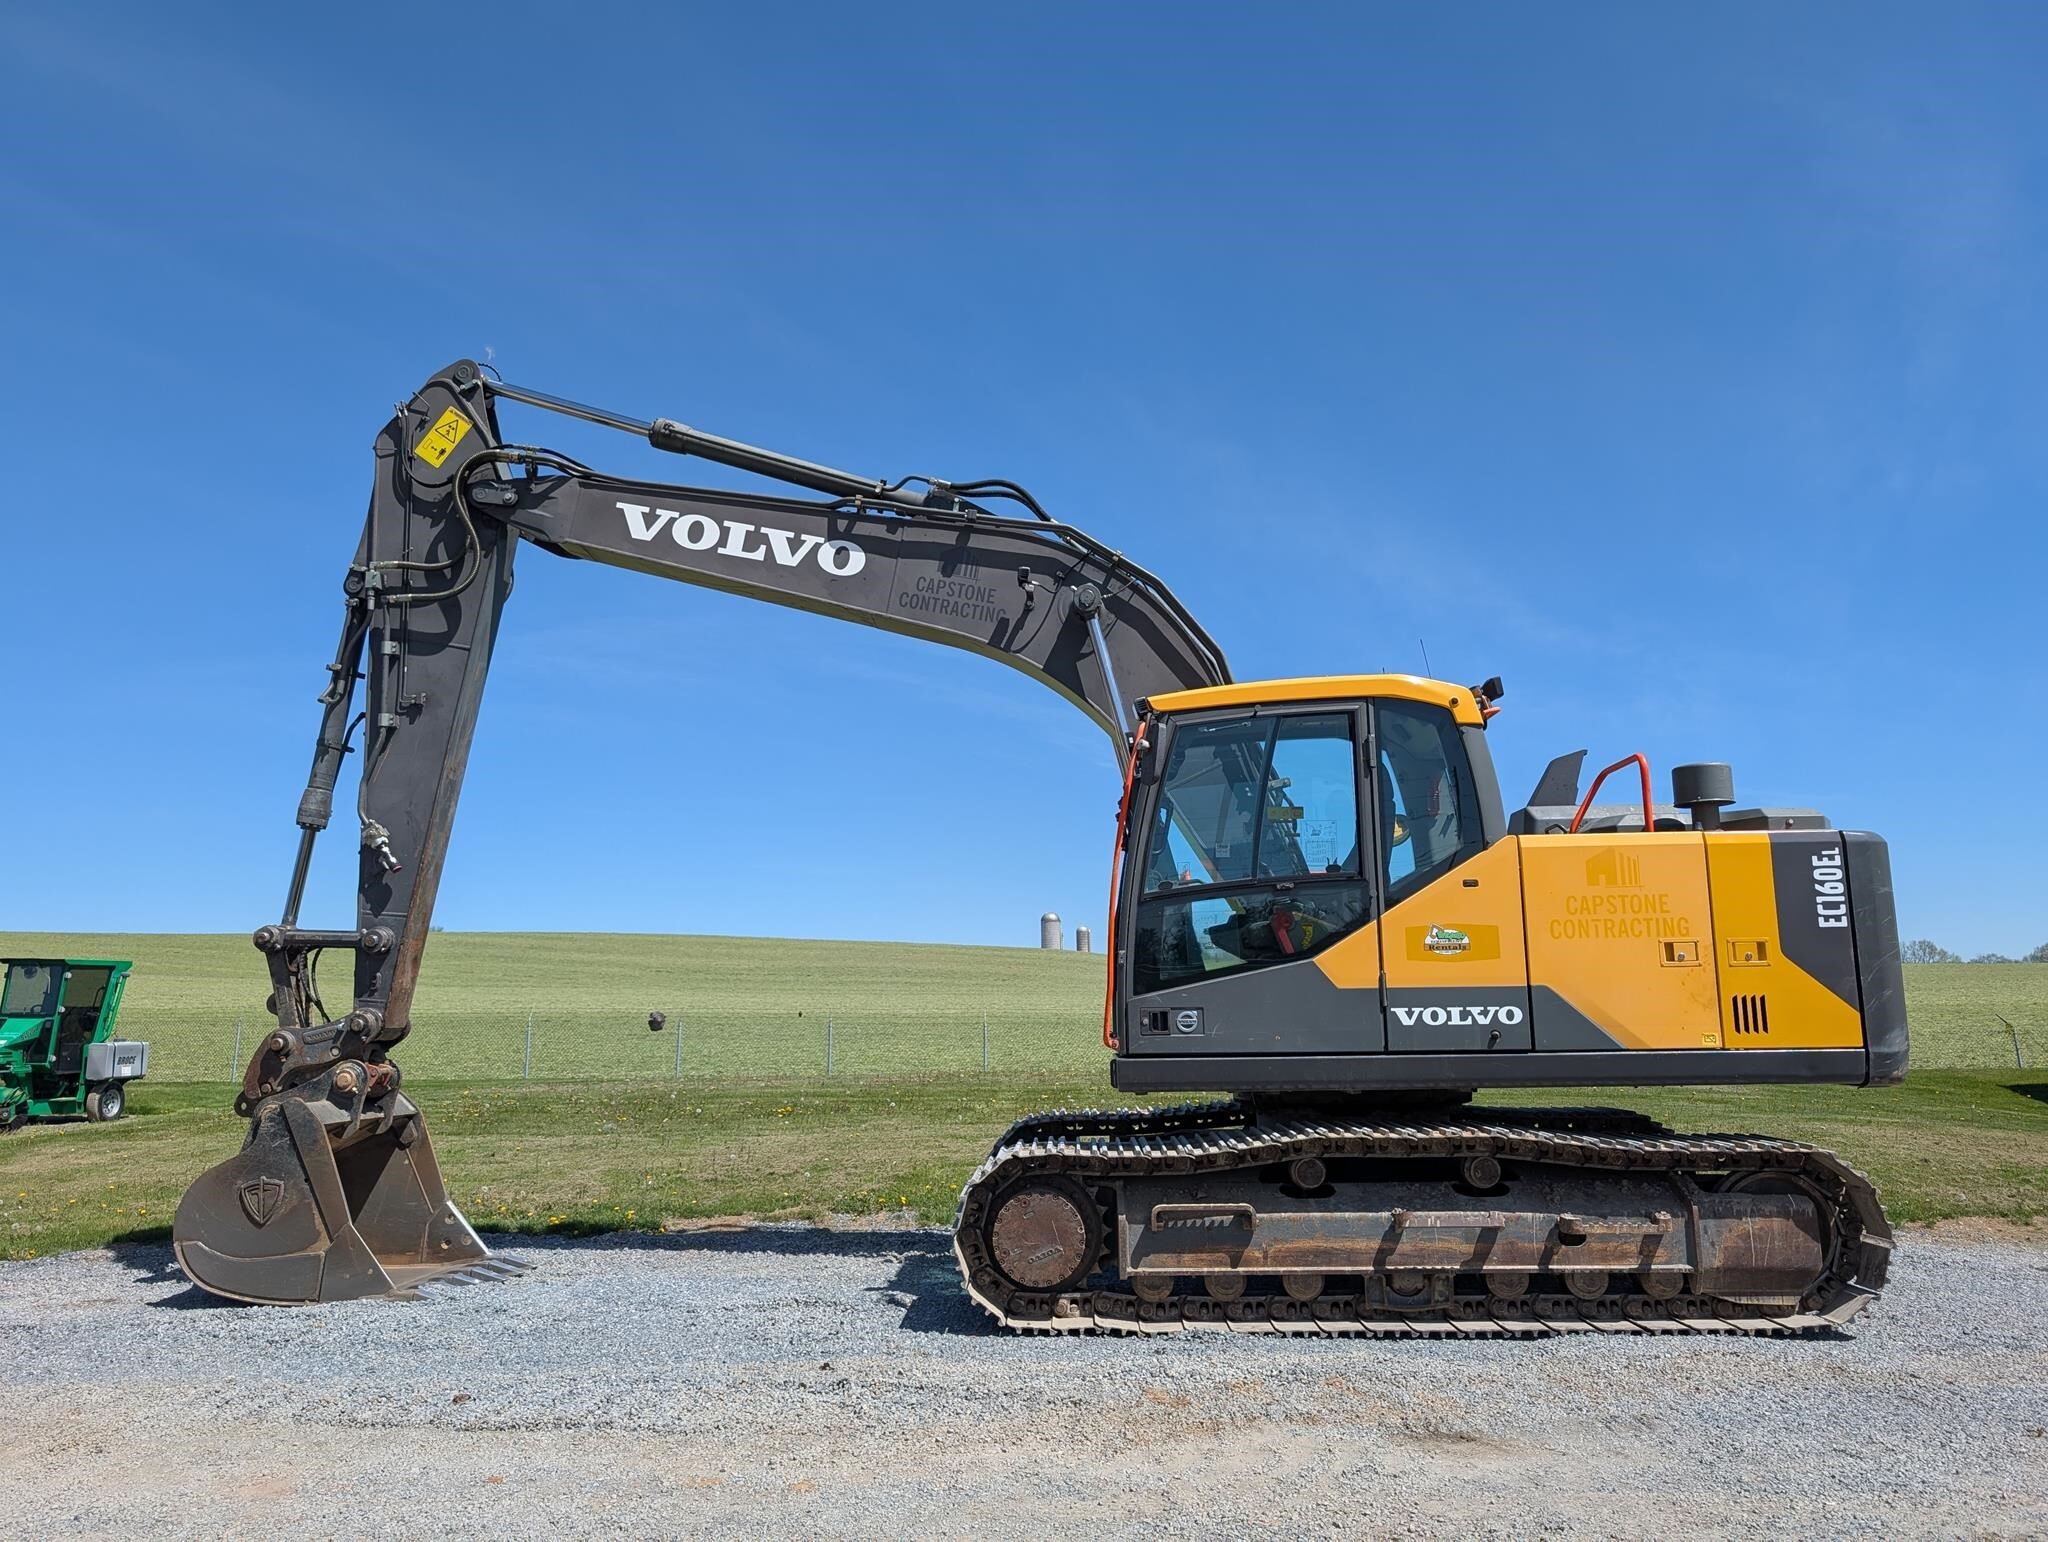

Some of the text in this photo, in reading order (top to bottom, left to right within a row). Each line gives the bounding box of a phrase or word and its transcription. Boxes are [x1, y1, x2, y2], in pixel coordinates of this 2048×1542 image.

[615, 502, 866, 577] VOLVO
[916, 576, 998, 604] CAPSTONE
[1811, 847, 1848, 928] EC160EL
[1566, 894, 1670, 916] CAPSTONE
[1549, 917, 1690, 940] CONTRACTING
[1390, 1006, 1523, 1026] VOLVO
